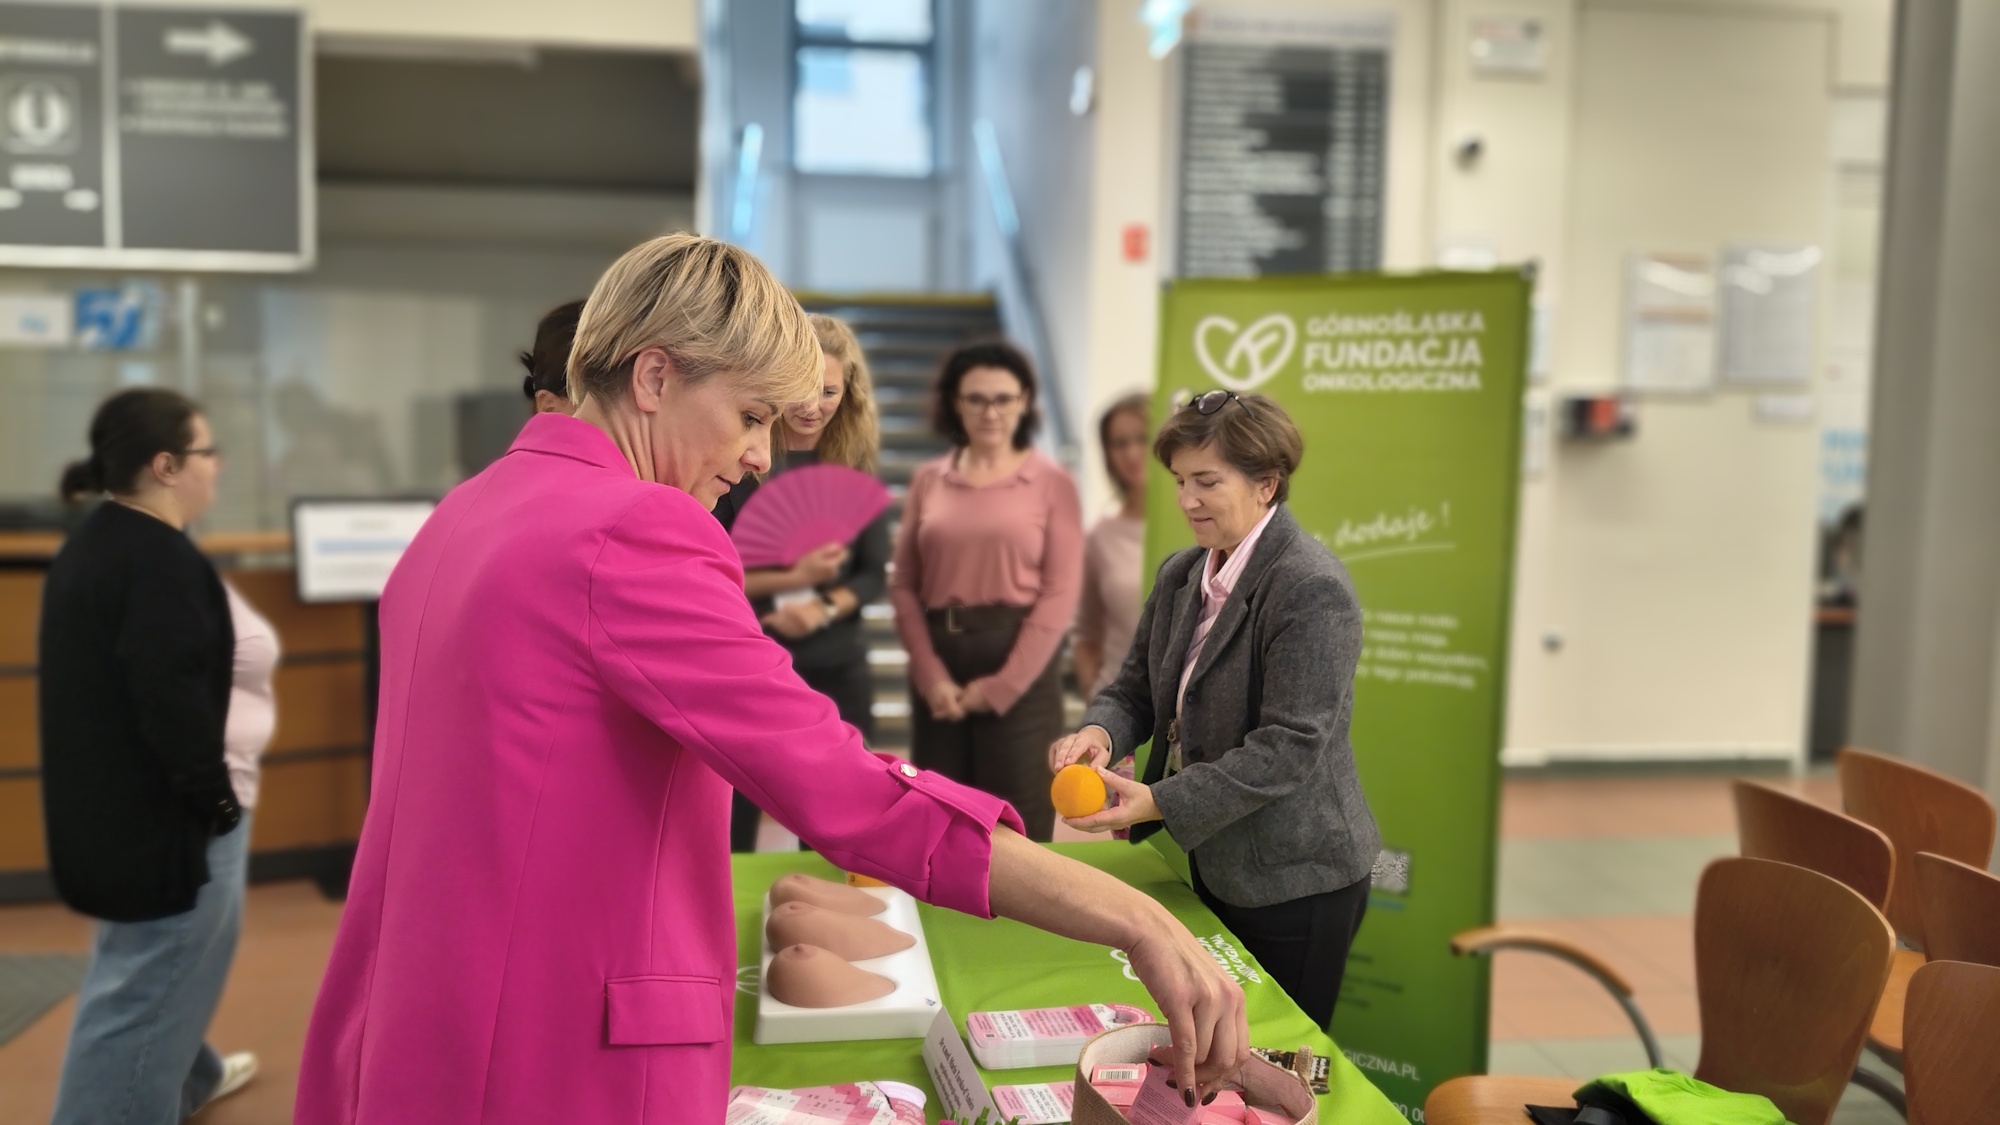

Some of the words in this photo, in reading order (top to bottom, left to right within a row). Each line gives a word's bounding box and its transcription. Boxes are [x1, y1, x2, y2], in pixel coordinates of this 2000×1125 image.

[1306, 309, 1485, 338] GÓRNOŚLĄSKA
[1303, 339, 1482, 369] FUNDACJA
[1302, 370, 1481, 392] ONKOLOGICZNA
